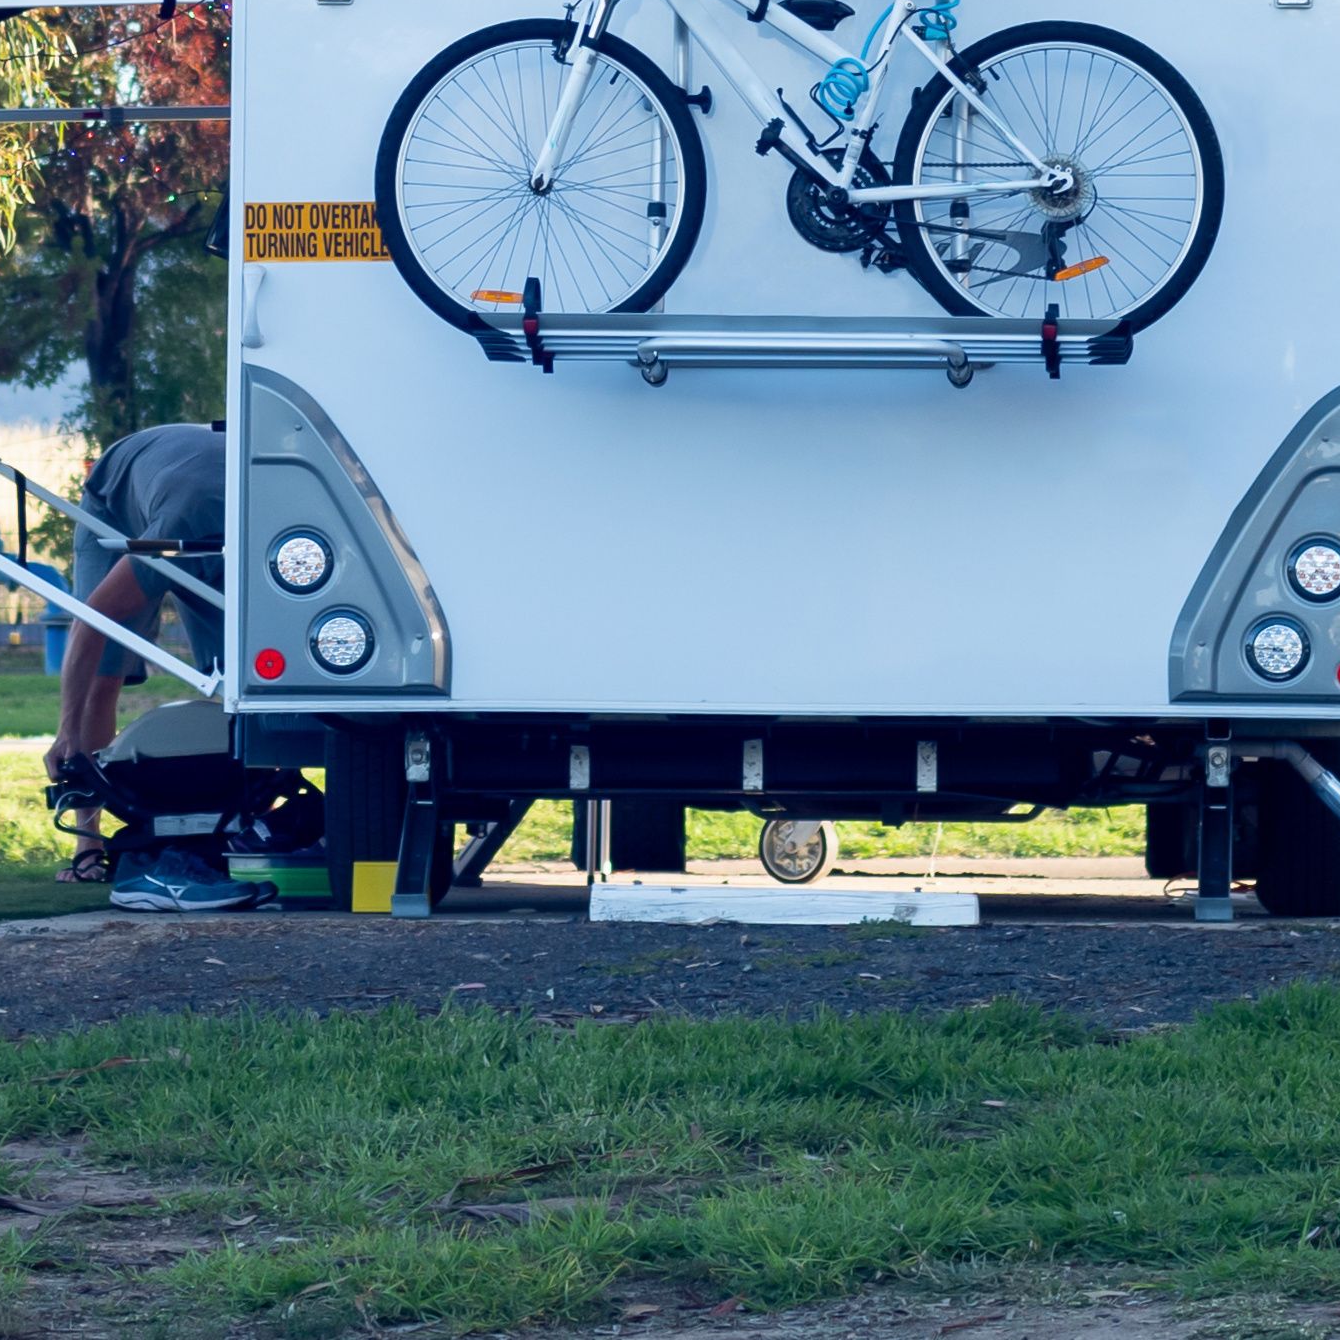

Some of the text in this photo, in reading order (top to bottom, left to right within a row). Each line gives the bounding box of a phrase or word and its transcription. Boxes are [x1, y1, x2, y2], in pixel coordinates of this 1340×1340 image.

[245, 204, 379, 229] DO NOT OVERTAK
[246, 232, 317, 257] TURNING
